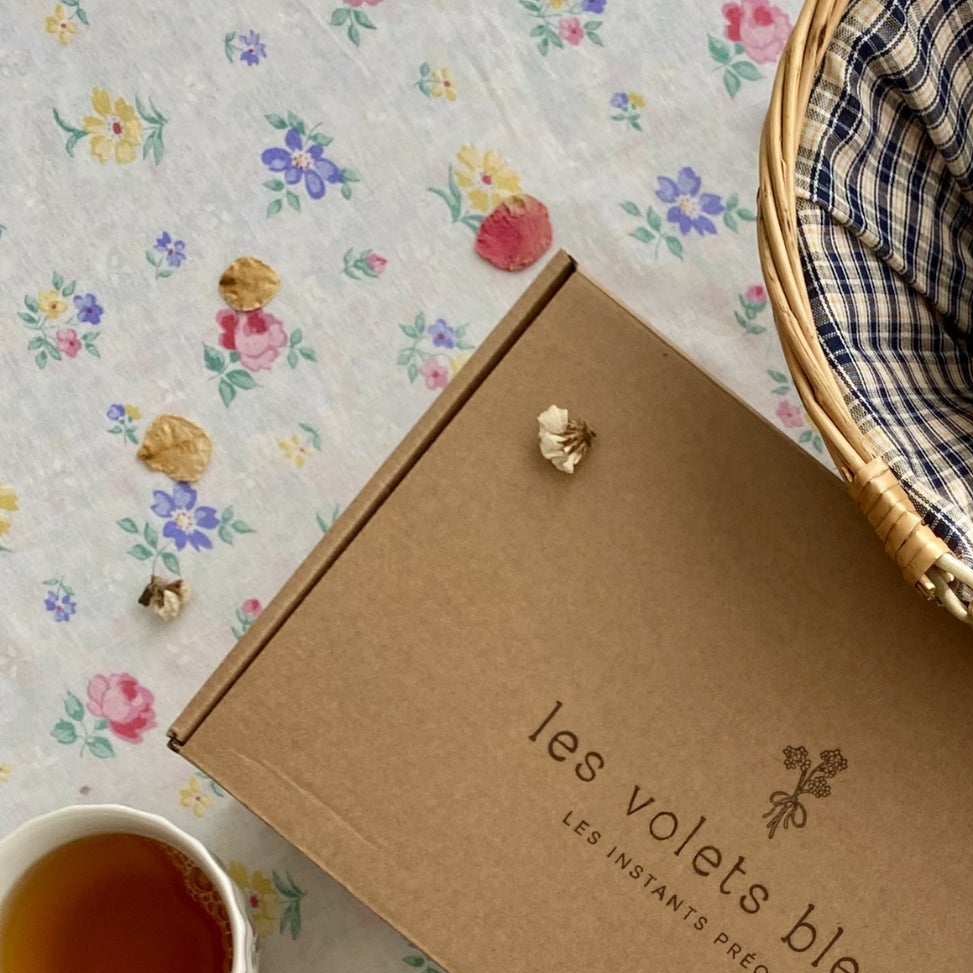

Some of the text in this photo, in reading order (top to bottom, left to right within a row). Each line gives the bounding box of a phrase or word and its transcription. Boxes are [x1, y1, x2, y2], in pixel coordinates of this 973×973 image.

[528, 700, 605, 782] les
[626, 785, 769, 914] volets
[562, 811, 601, 845] LES
[606, 846, 708, 931] INSTANTS
